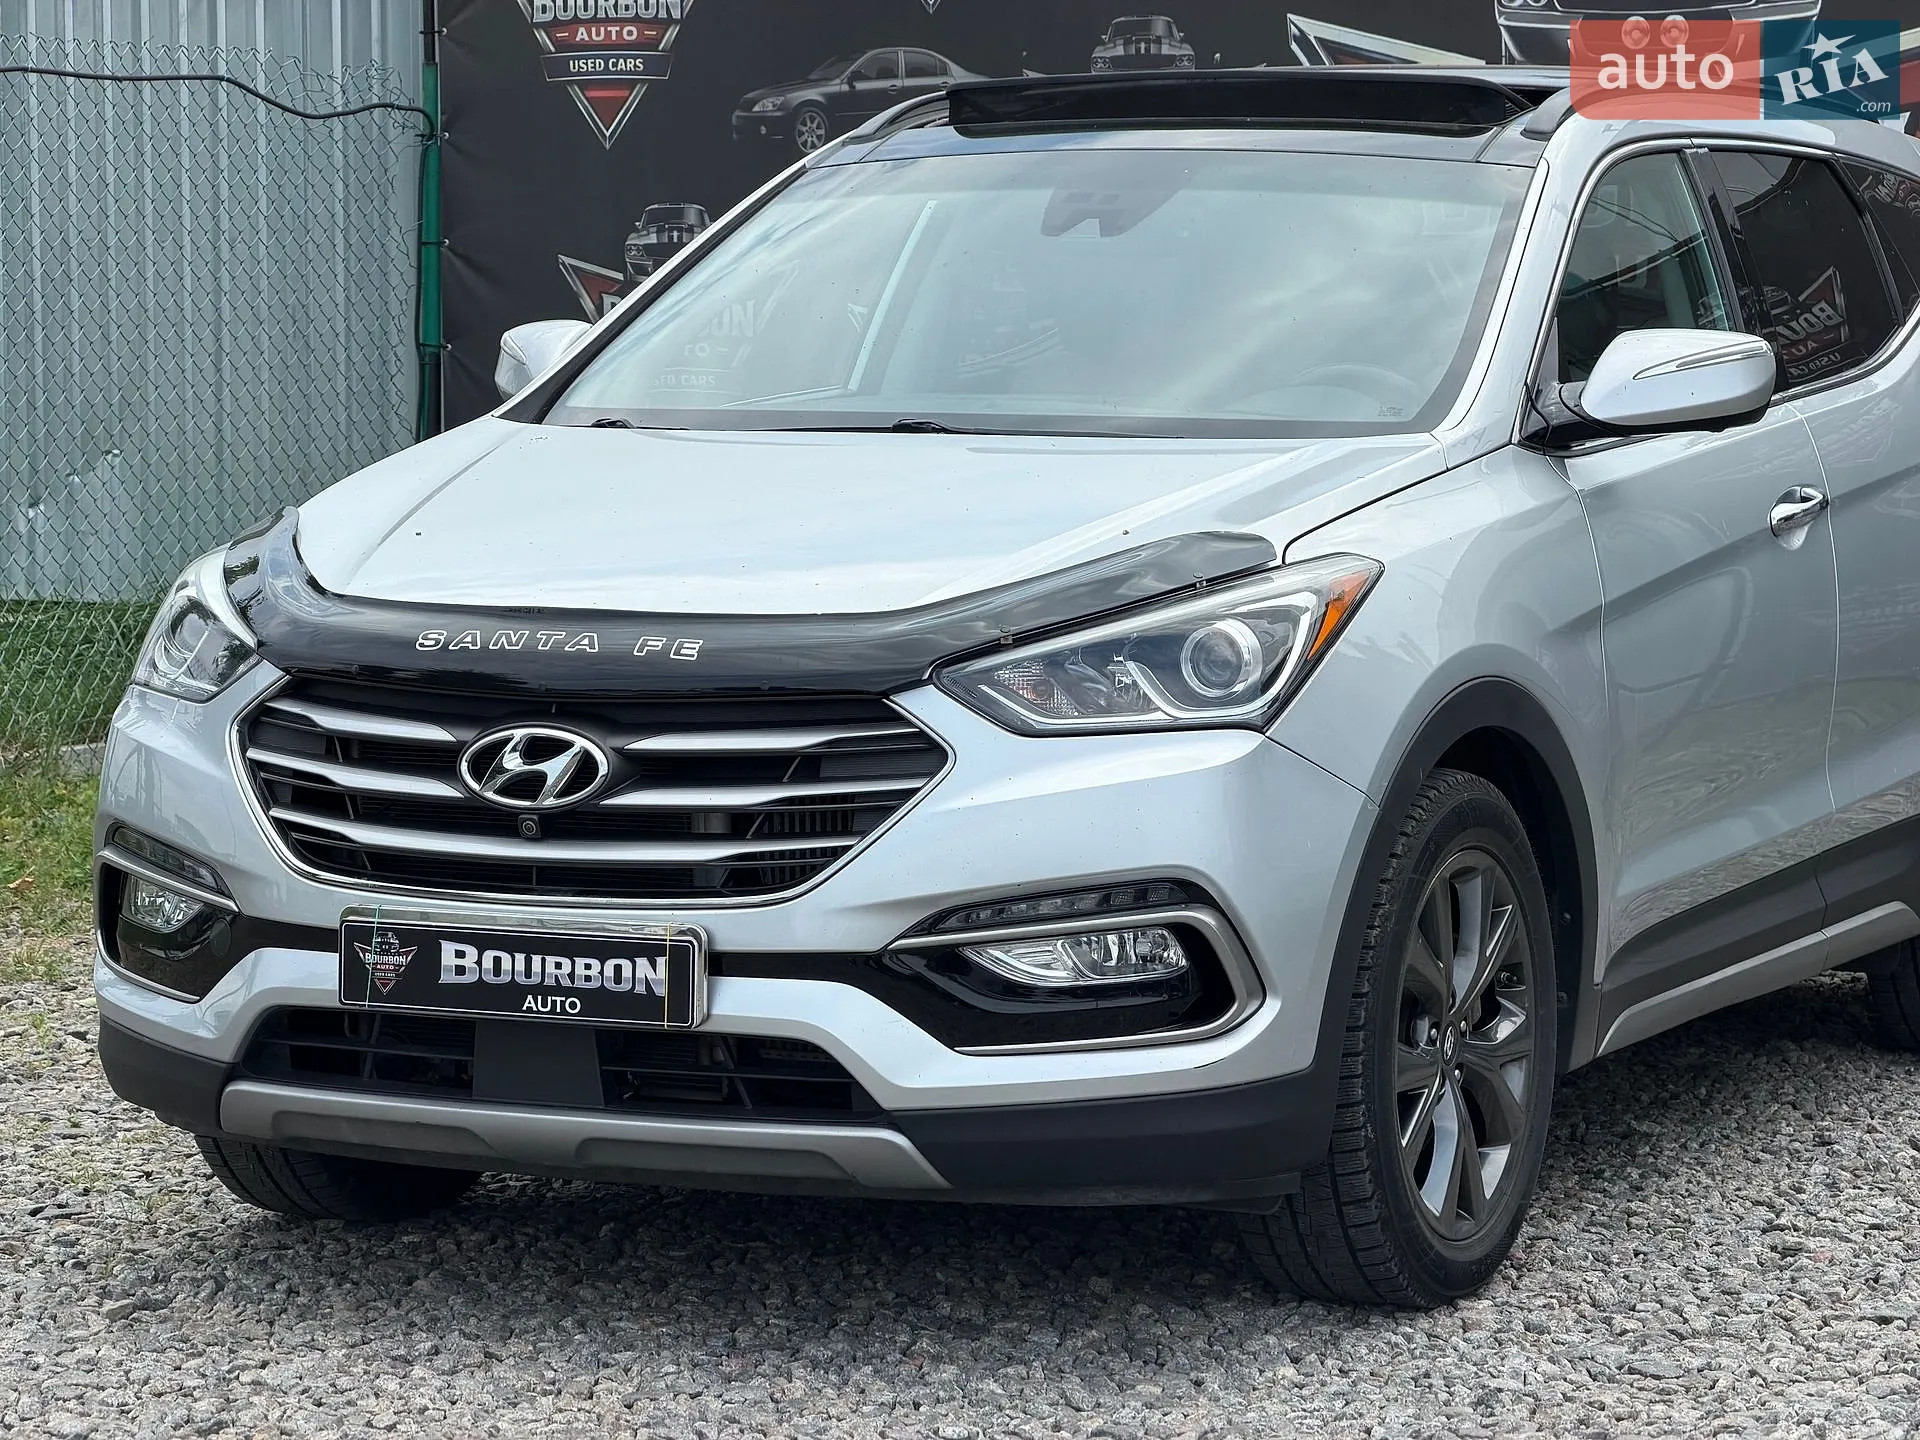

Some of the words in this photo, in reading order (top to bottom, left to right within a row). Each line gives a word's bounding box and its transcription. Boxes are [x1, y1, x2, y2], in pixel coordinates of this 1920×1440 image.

[575, 26, 638, 41] AUTO
[569, 59, 604, 73] USED
[608, 58, 644, 71] CARS
[681, 374, 716, 387] CARS
[415, 630, 599, 652] SANTA
[633, 636, 704, 661] FE
[365, 952, 407, 966] BOURBON
[438, 939, 668, 997] BOURBON
[522, 994, 582, 1014] AUTO
